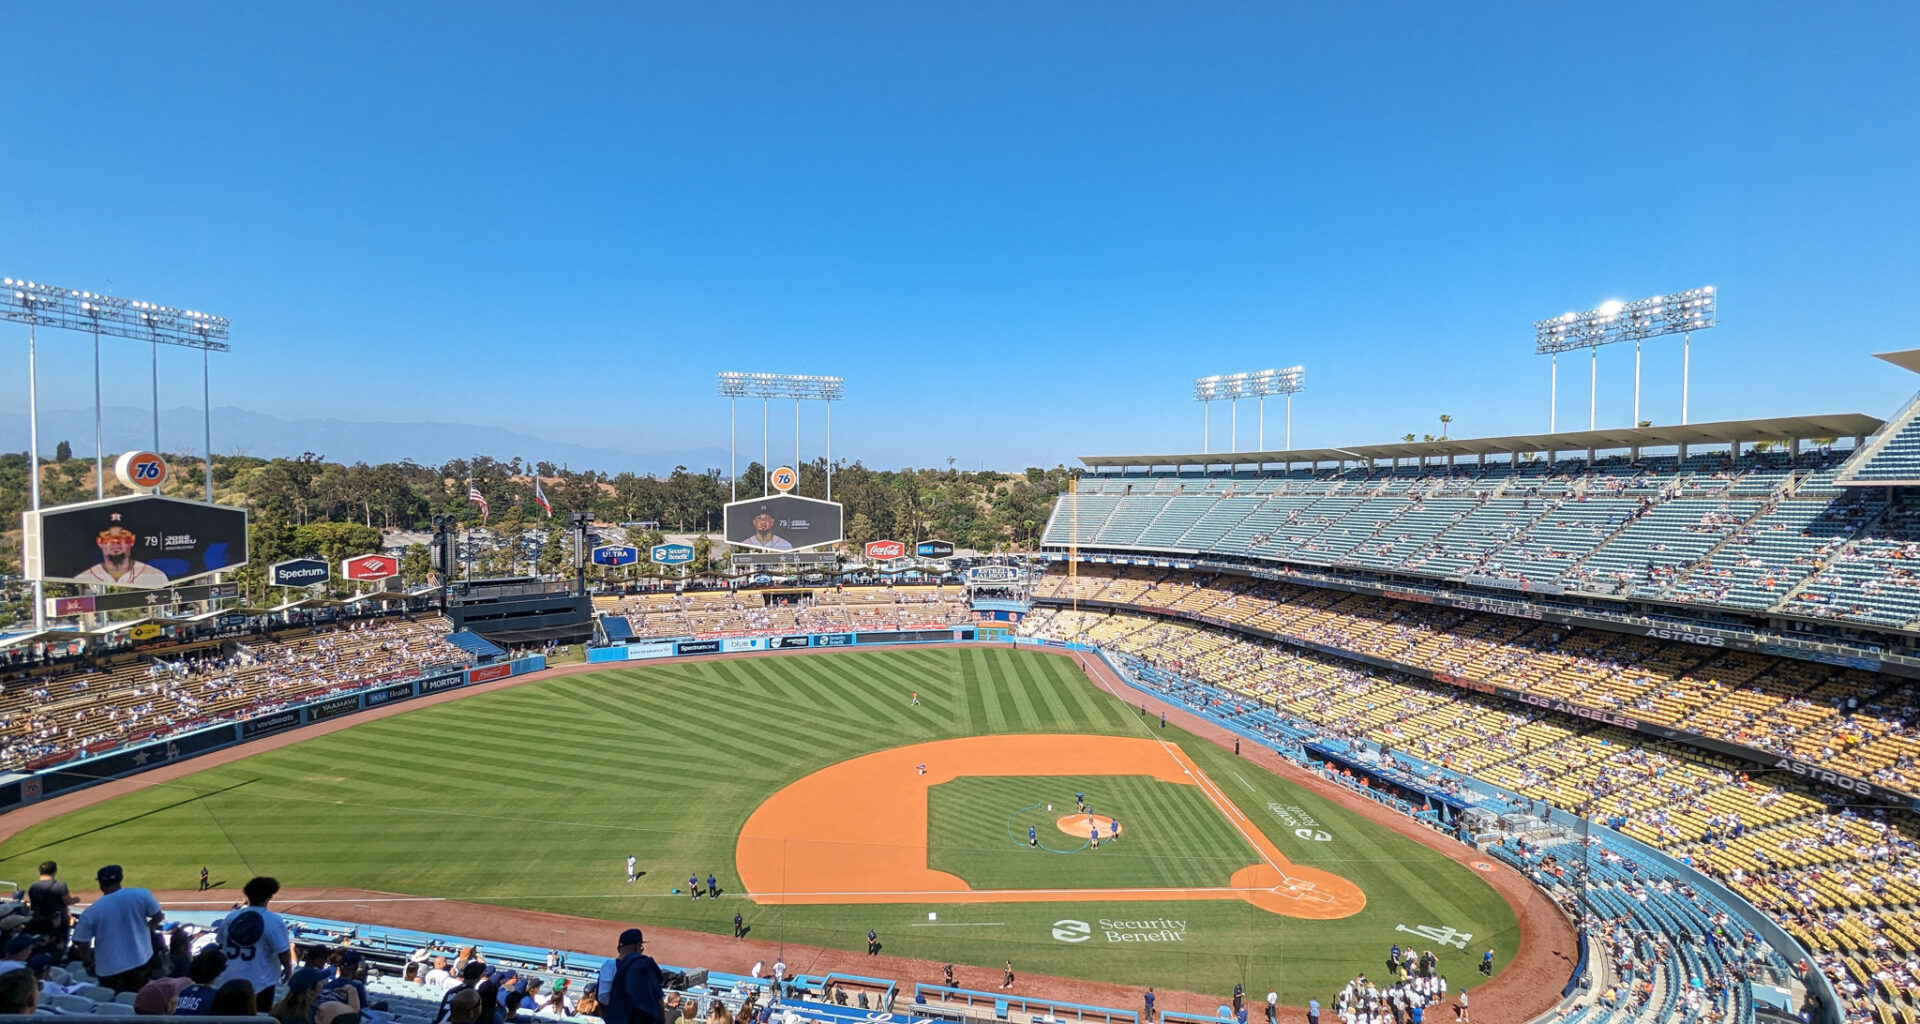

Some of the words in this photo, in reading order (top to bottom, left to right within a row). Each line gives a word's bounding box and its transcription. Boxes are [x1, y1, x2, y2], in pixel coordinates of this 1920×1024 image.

[136, 462, 160, 479] 76
[777, 474, 791, 485] 76
[144, 536, 158, 547] 79
[668, 548, 690, 556] Security
[869, 544, 899, 556] Coca-Cola
[279, 568, 323, 580] Spectrum
[1251, 572, 1278, 581] ASTROS
[1452, 600, 1476, 610] LOS
[1479, 604, 1543, 620] ANGELES
[731, 639, 748, 647] blue
[1645, 628, 1725, 647] ASTROS
[430, 676, 461, 689] MORTON
[371, 694, 387, 702] UCLA
[389, 687, 410, 698] Health
[1518, 694, 1550, 708] LOS
[1554, 702, 1638, 730] ANGELES
[1774, 758, 1872, 796] ASTROS
[1099, 918, 1187, 931] Security
[1105, 930, 1184, 942] Benefit
[1395, 923, 1473, 949] LA
